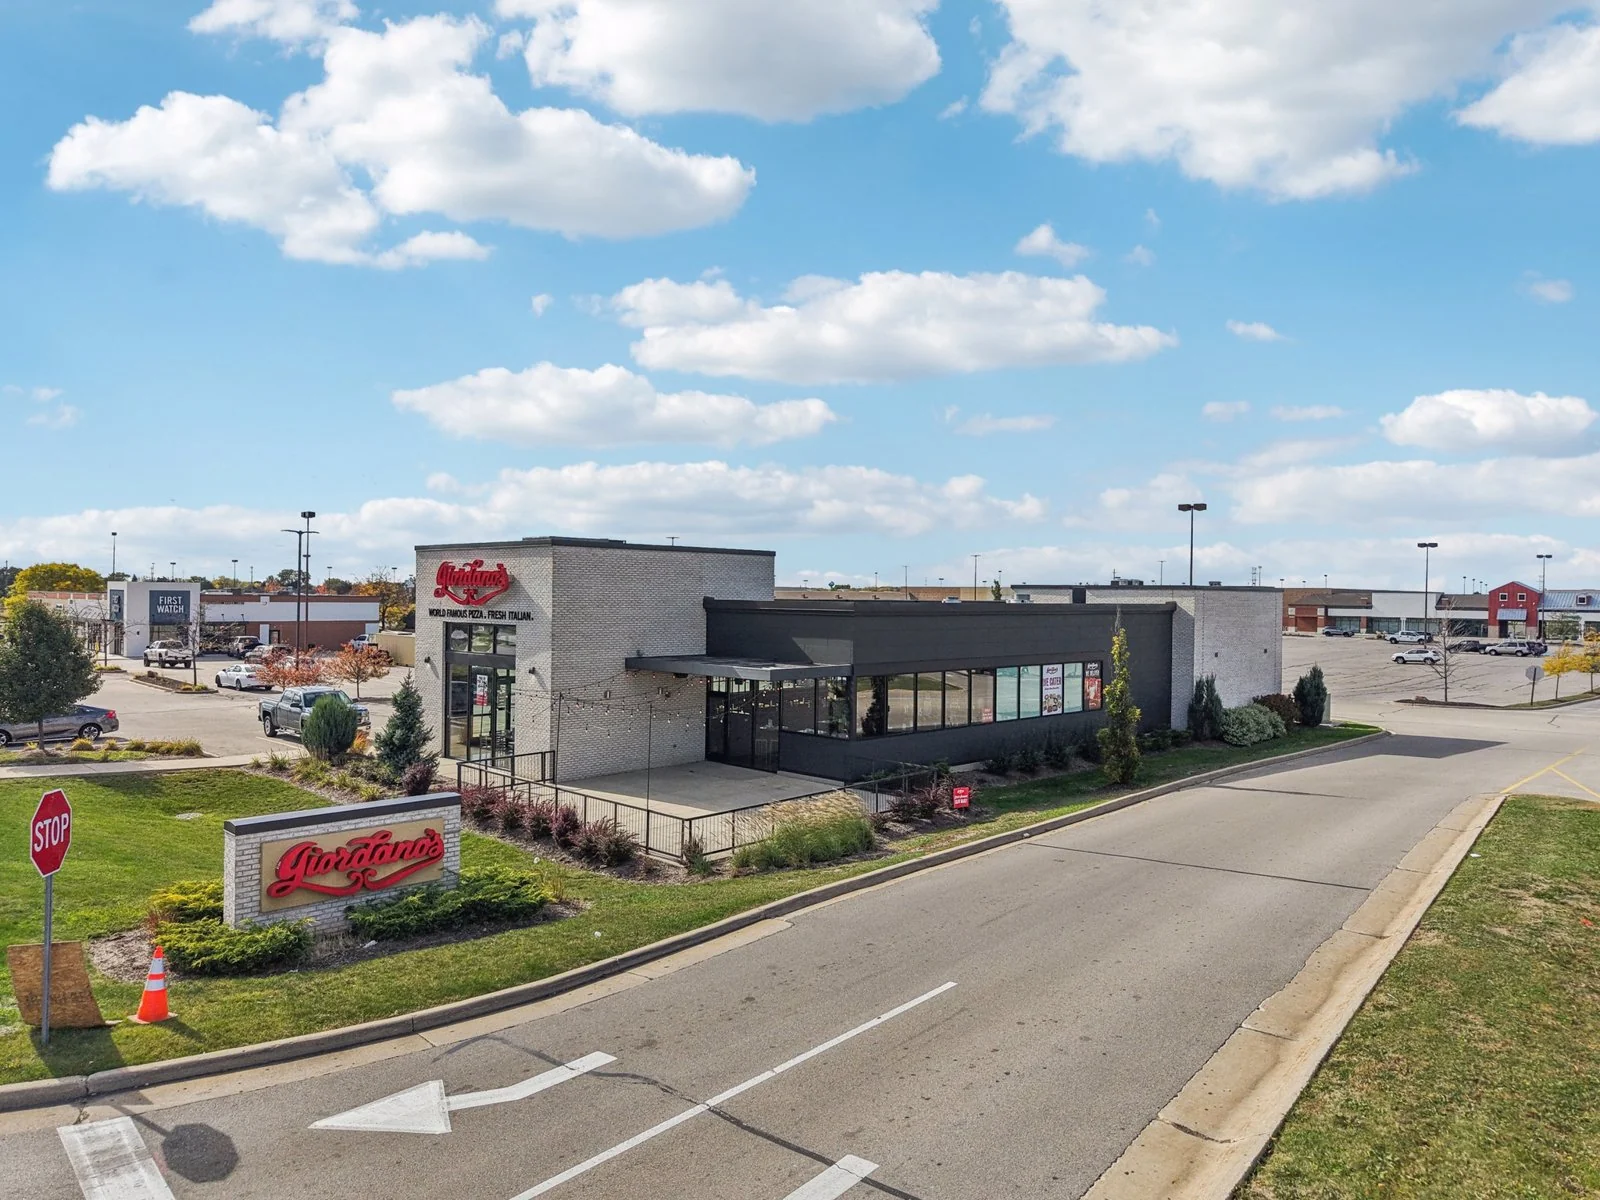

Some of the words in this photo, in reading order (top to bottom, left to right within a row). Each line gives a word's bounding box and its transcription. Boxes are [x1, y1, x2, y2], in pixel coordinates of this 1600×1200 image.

[159, 596, 182, 605] FIRST
[156, 605, 184, 613] WATCH
[428, 608, 446, 617] WORLD
[446, 609, 468, 618] FAMOUS
[487, 611, 506, 620] FRESH
[1050, 677, 1061, 686] CATER
[34, 813, 69, 852] STOP
[266, 828, 445, 898] Giordano's
